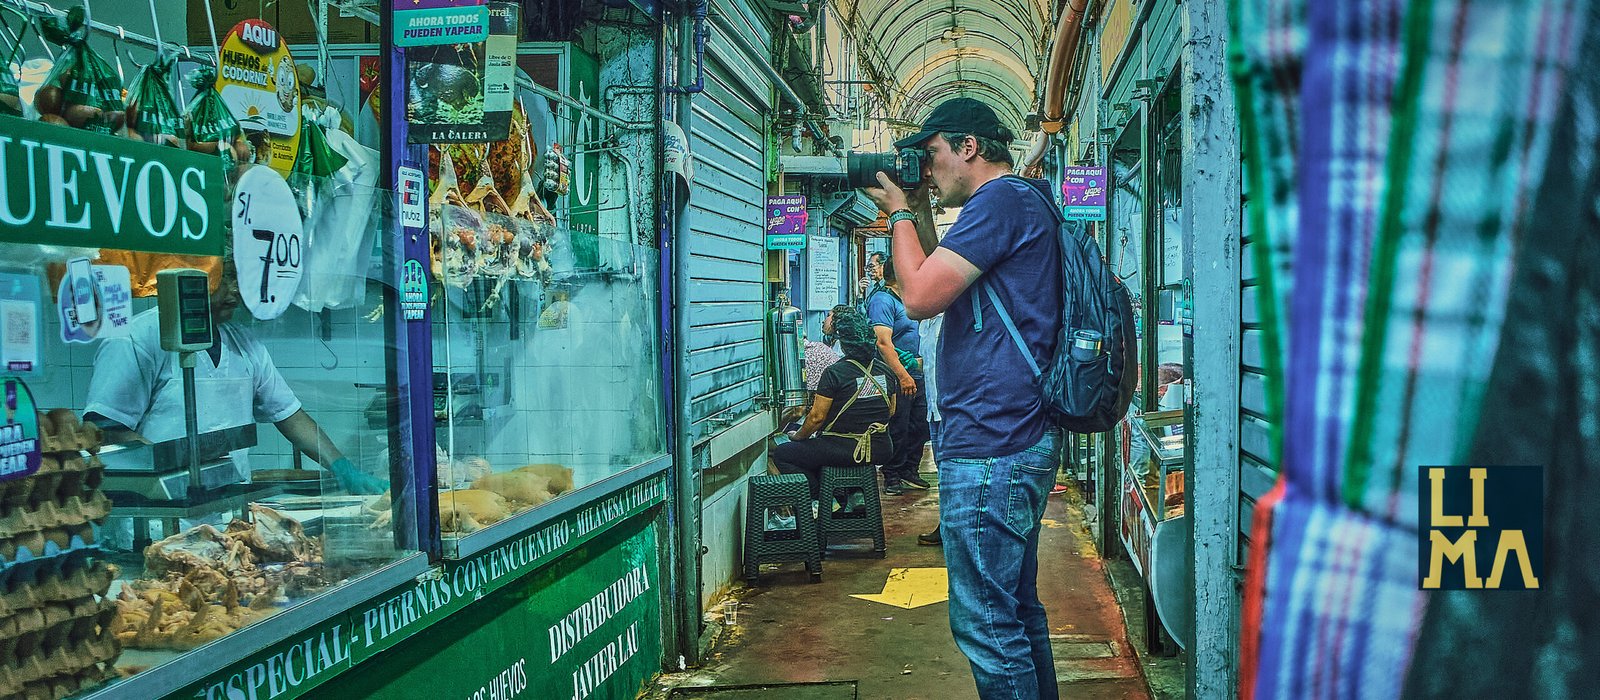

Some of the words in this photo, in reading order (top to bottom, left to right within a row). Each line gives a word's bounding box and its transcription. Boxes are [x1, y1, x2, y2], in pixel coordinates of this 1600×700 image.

[409, 17, 443, 27] AHORA
[446, 14, 479, 25] TODOS
[242, 22, 276, 48] AQUI
[404, 28, 442, 39] PUEDEN
[445, 25, 482, 36] YAPEAR
[223, 49, 260, 70] HUEVOS
[222, 64, 267, 86] CODORNIZ
[432, 132, 445, 140] LA
[448, 130, 487, 140] CALERA
[1082, 187, 1102, 202] yape
[767, 215, 786, 231] yape
[363, 573, 451, 648] PIERNAS
[453, 556, 487, 598] CON
[487, 519, 569, 580] ENCUENTRO
[576, 494, 624, 538] MILANESA
[548, 562, 650, 665] DISTRIBUIDORA
[572, 640, 617, 700] JAVIER
[617, 621, 639, 667] LAU
[489, 658, 527, 700] HUEVOS
